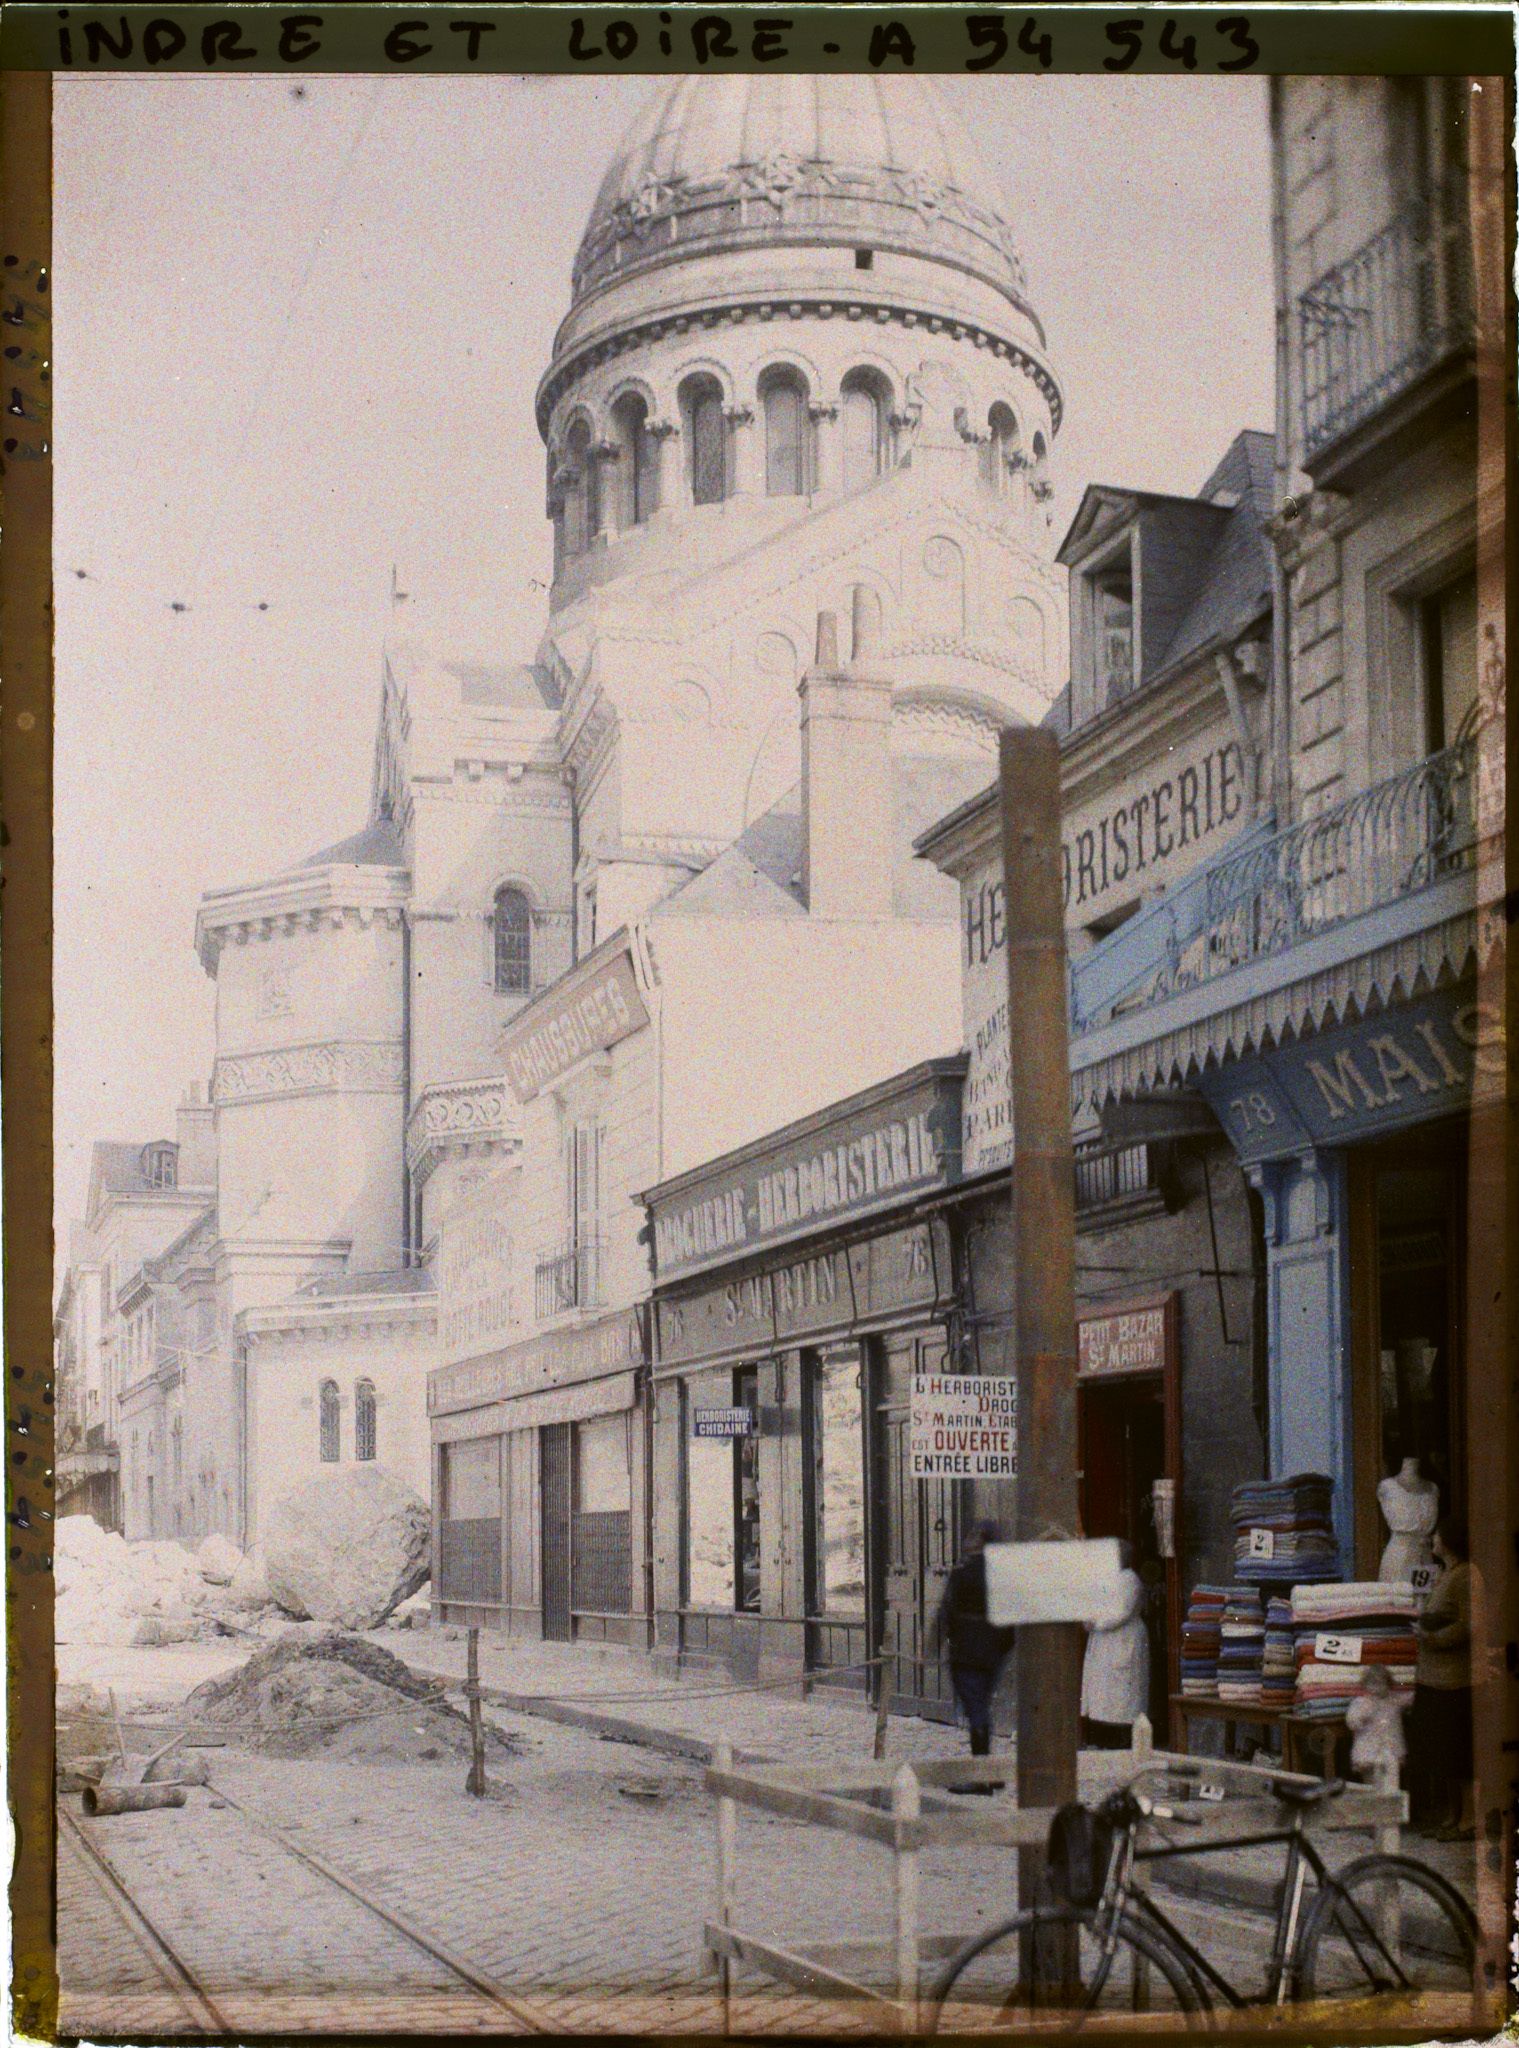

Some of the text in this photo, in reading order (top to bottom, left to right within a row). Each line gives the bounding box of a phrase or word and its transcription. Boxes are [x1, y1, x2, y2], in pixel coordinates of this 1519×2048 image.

[966, 742, 1245, 968] HERISTERIE
[757, 1110, 940, 1234] HERBORISTERIE
[1119, 1308, 1164, 1341] BAZAR
[698, 1422, 748, 1435] CHIDAINE
[935, 1430, 1011, 1452] OUVERTE
[1321, 1639, 1341, 1654] 2
